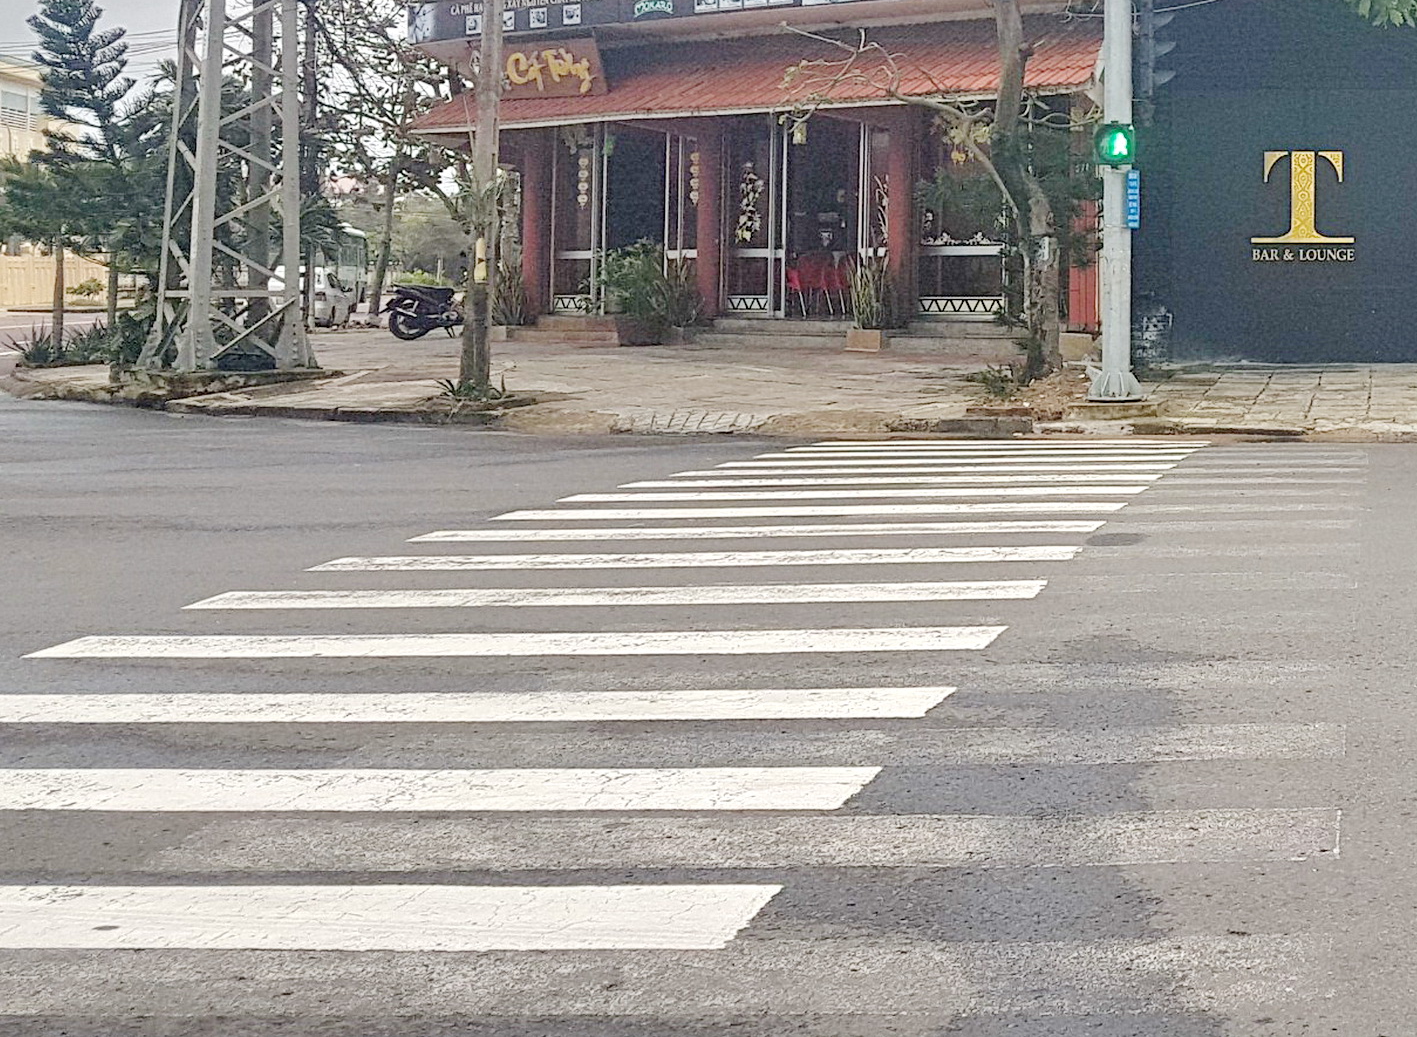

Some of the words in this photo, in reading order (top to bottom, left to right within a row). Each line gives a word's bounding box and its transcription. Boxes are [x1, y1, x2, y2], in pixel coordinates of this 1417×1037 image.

[1250, 151, 1355, 244] T
[1252, 248, 1279, 261] BAR
[1283, 248, 1294, 261] &
[1299, 248, 1355, 261] LOUNGE
